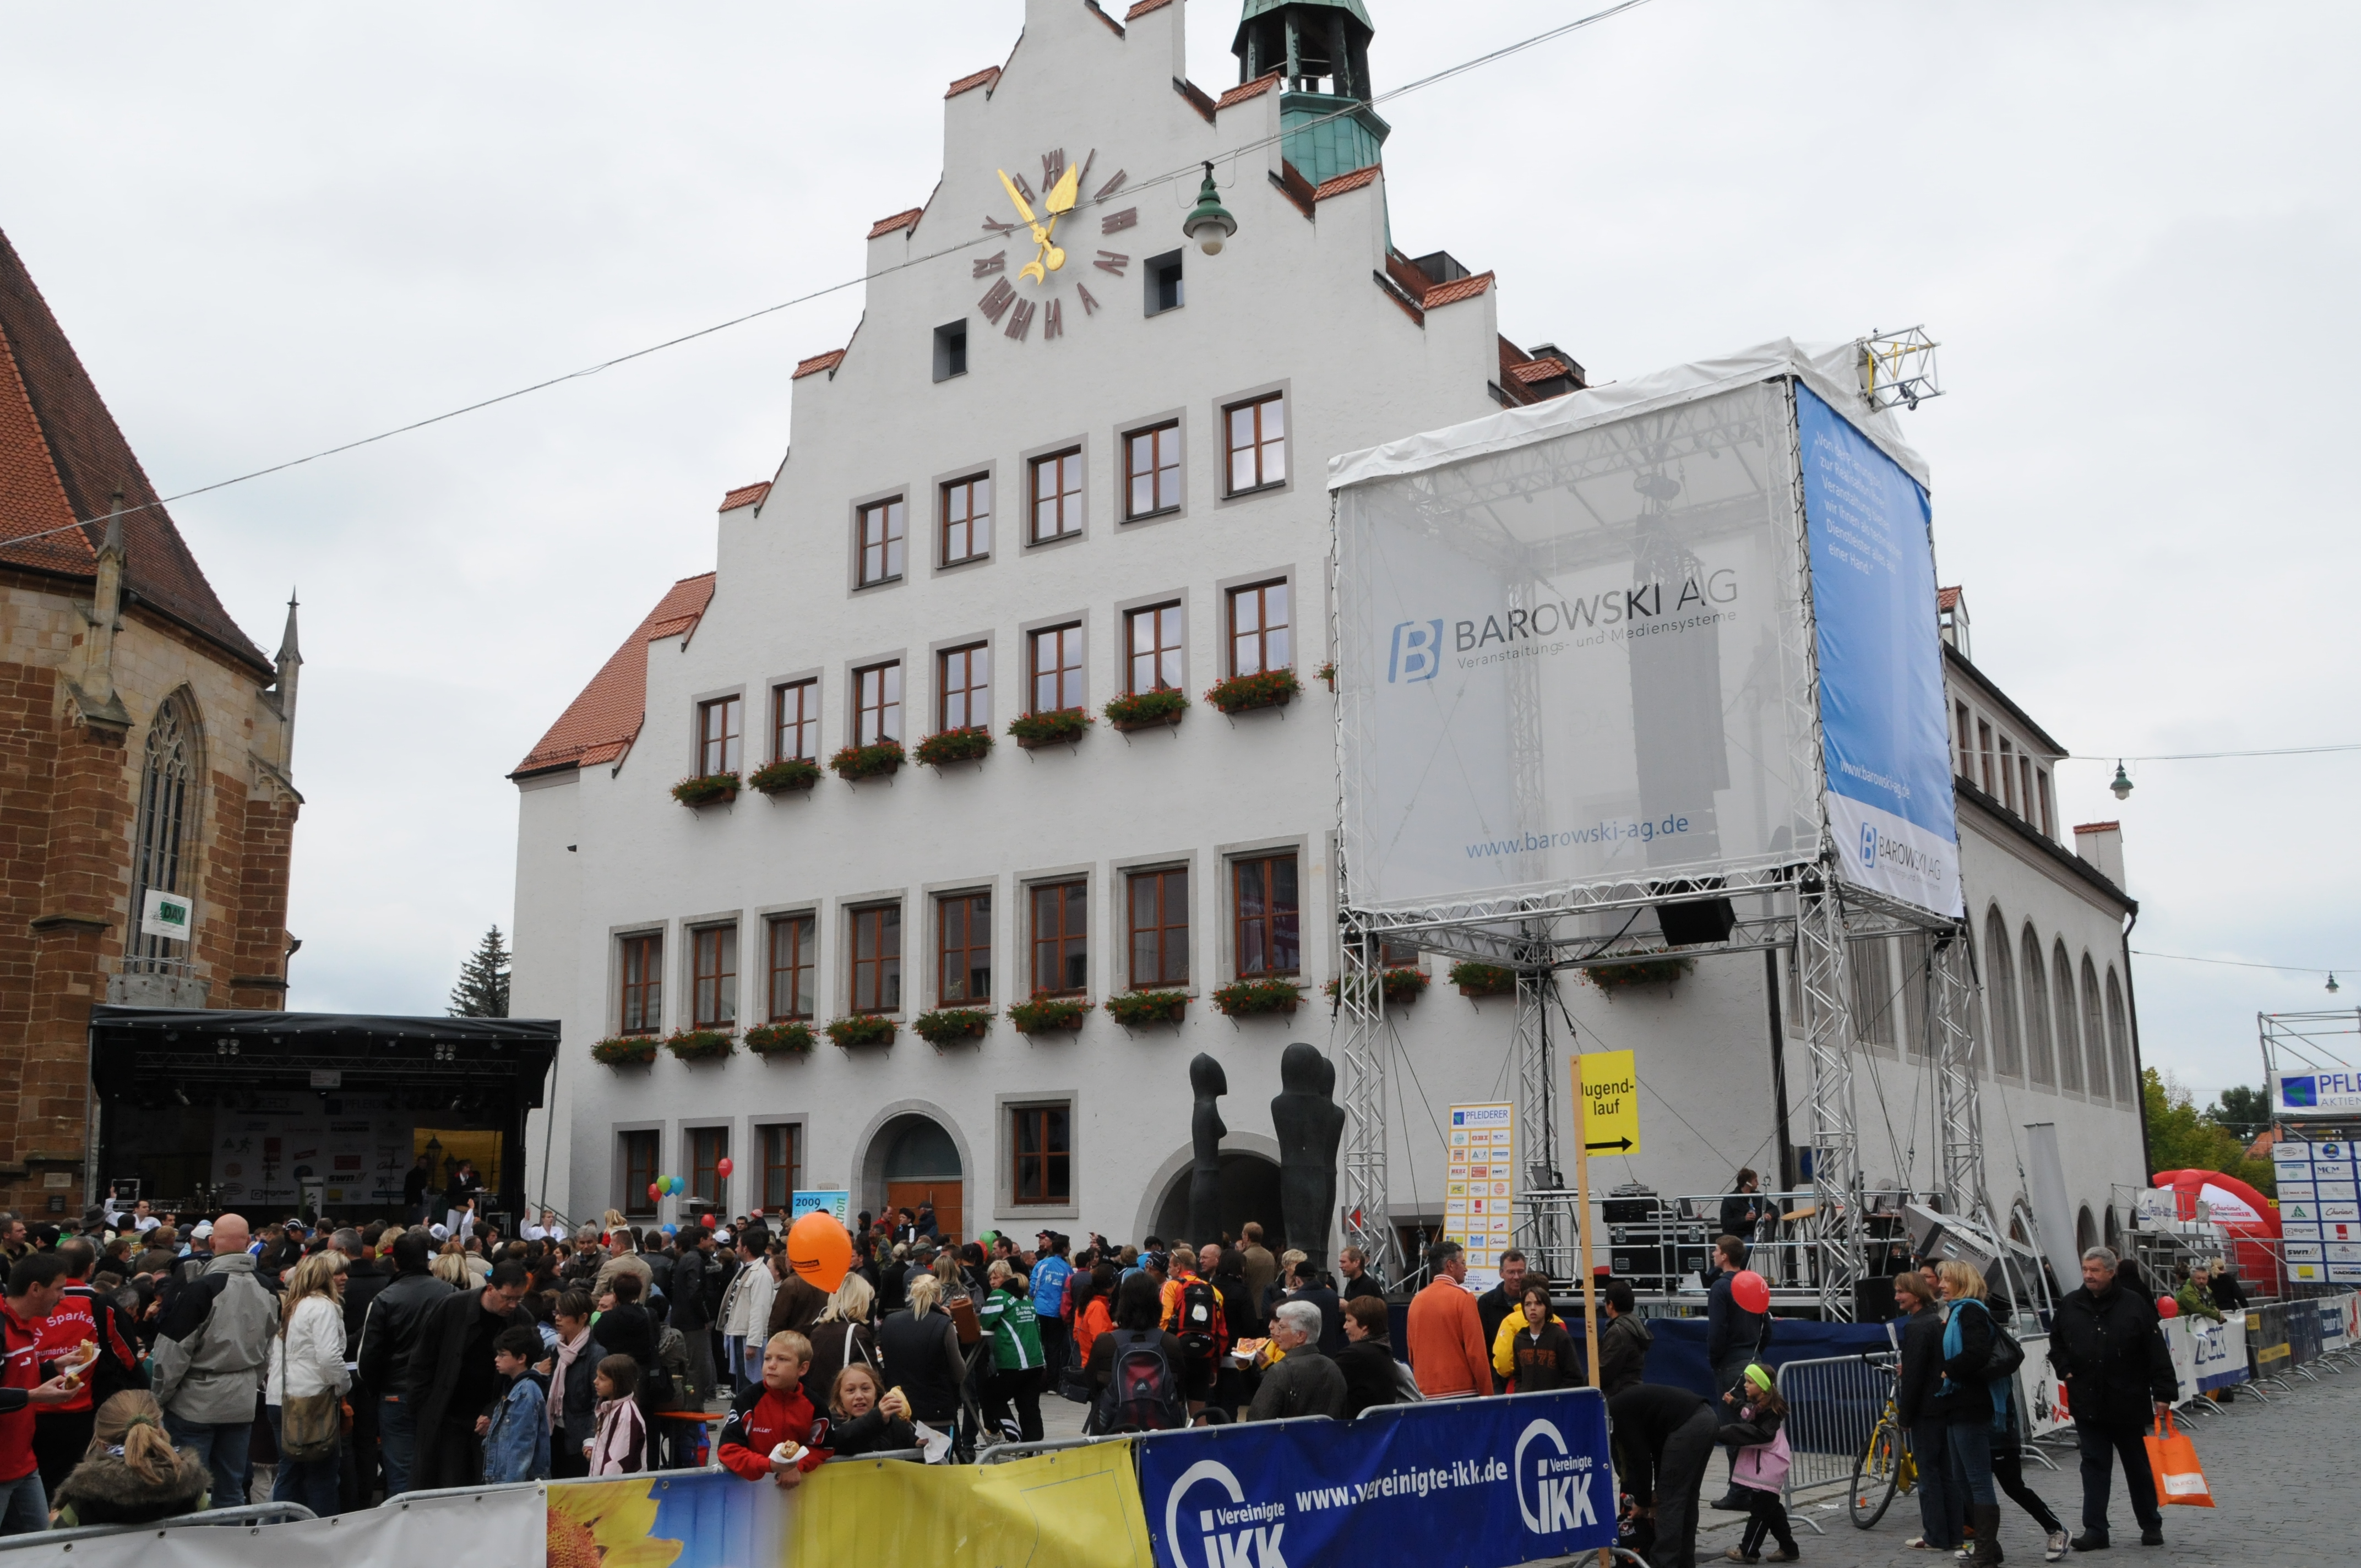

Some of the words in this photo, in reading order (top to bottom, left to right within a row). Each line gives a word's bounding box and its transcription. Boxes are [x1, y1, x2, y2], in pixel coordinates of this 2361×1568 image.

[1455, 582, 1661, 652] BAROWSKI
[1677, 568, 1738, 611] AG
[1457, 640, 1571, 669] Veranstaltungs-
[1577, 632, 1604, 648] und
[1612, 610, 1737, 642] Mediensysteme
[1841, 759, 1910, 799] www.barowski-ag.de
[1466, 814, 1689, 858] www.barowski-ag.de
[1879, 836, 1926, 873] BAROWSKI
[1928, 857, 1940, 880] AG
[2319, 1073, 2361, 1093] PFLE
[1466, 1110, 1508, 1119] PFLEIDERER
[1593, 1099, 1620, 1115] lauf
[2321, 1097, 2361, 1107] AKTIEN
[795, 1198, 821, 1209] 2009
[1943, 1228, 1982, 1255] SPORTRONIC
[1550, 1455, 1592, 1474] Vereinigte
[1296, 1457, 1508, 1512] www.vereinigte-ikk.de
[1217, 1501, 1285, 1527] Vereinigte
